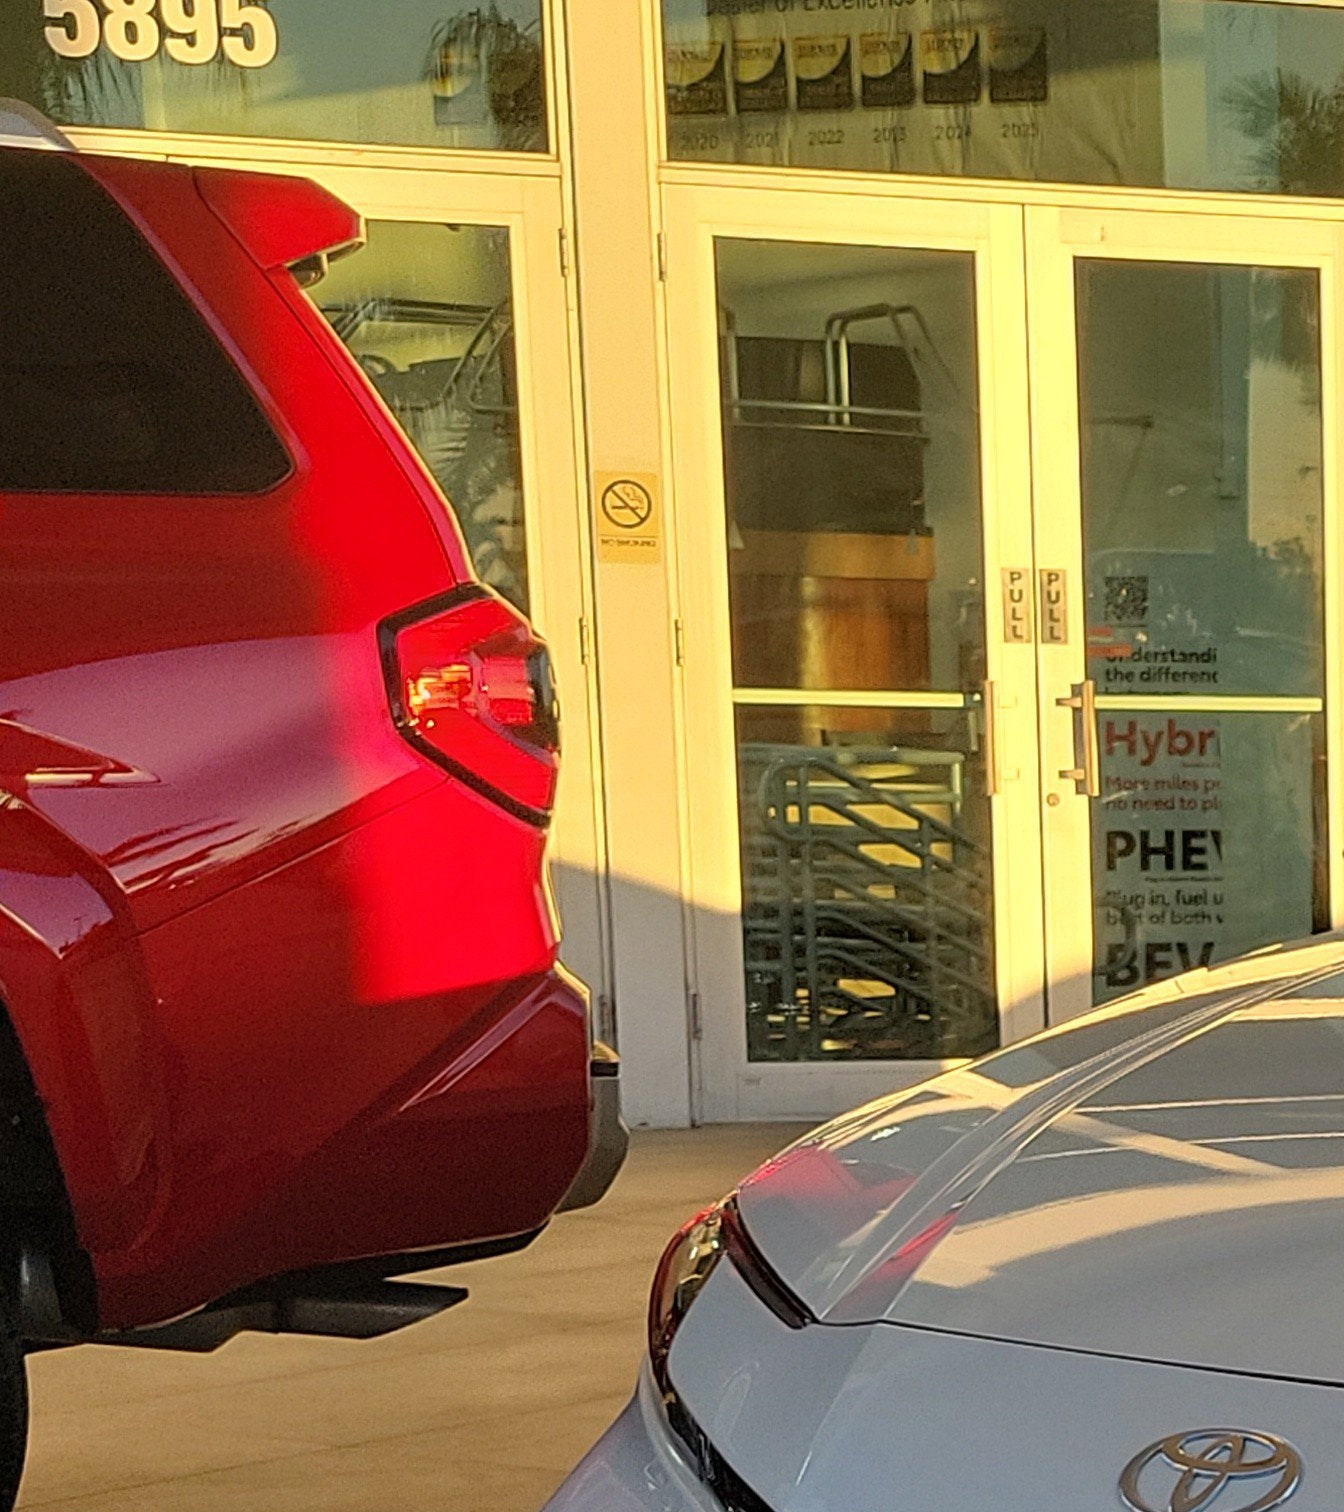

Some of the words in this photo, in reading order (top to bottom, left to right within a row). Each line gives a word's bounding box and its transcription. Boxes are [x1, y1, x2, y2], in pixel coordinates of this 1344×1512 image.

[43, 0, 278, 68] 5895
[1009, 570, 1024, 640] PULL
[1046, 571, 1062, 641] PULL
[1105, 666, 1136, 682] the
[1105, 718, 1216, 767] Hybr
[1154, 774, 1199, 791] miles
[1132, 795, 1175, 811] need
[1180, 797, 1198, 811] to
[1175, 888, 1208, 906] fuel
[1150, 910, 1166, 924] of
[1171, 910, 1212, 925] both
[1106, 941, 1215, 987] BEV
